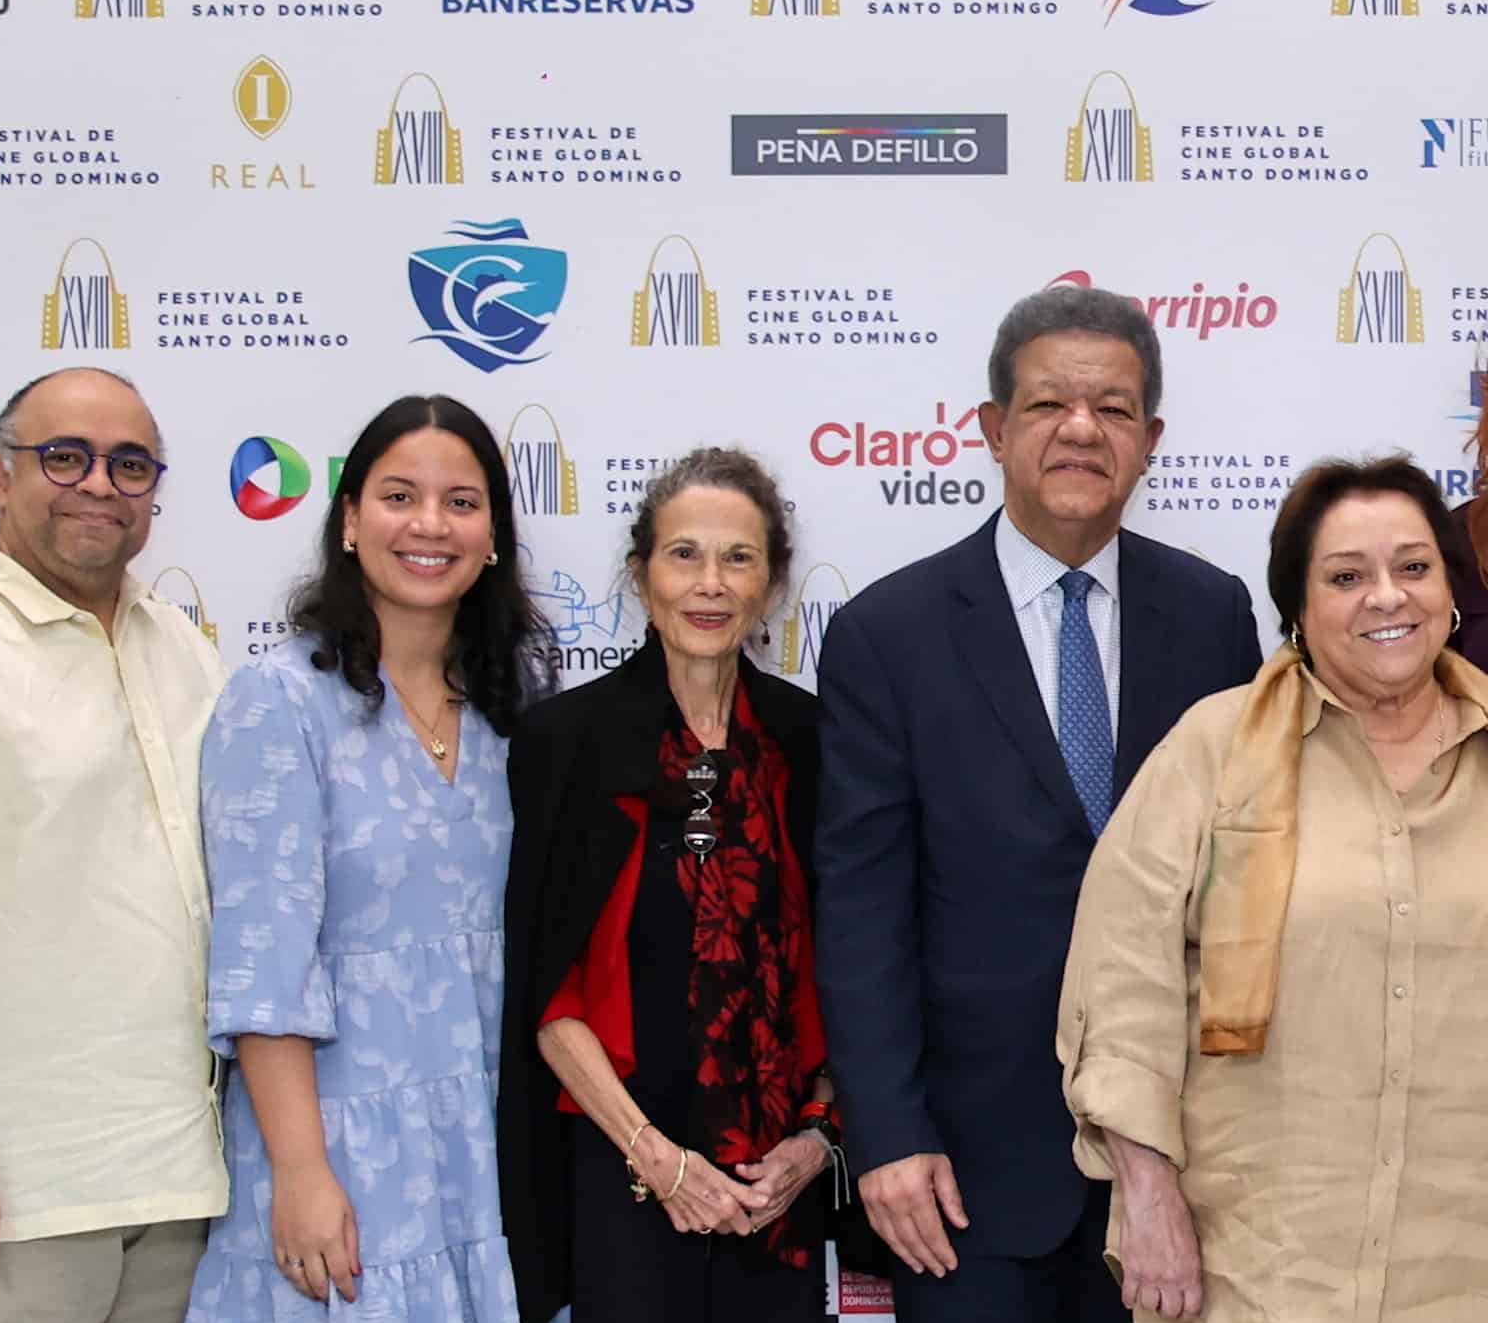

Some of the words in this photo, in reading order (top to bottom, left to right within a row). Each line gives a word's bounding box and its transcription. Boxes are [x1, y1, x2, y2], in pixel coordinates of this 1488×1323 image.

[192, 4, 265, 17] SANTO
[278, 3, 383, 17] DOMINGO
[867, 2, 941, 15] SANTO
[953, 1, 1058, 15] DOMINGO
[88, 129, 114, 142] DE
[1181, 125, 1286, 138] FESTIVAL
[1297, 125, 1324, 138] DE
[33, 151, 120, 164] GLOBAL
[852, 139, 978, 163] DEFILLO
[1181, 146, 1232, 159] CINE
[1243, 146, 1330, 159] GLOBAL
[55, 171, 160, 185] DOMINGO
[211, 163, 316, 189] REAL
[1181, 168, 1254, 181] SANTO
[1265, 168, 1369, 181] DOMINGO
[747, 289, 854, 302] FESTIVAL
[866, 288, 893, 302] DE
[747, 310, 799, 324] CINE
[811, 310, 899, 323] GLOBAL
[1130, 282, 1277, 340] rripio
[748, 331, 822, 345] SANTO
[833, 331, 938, 345] DOMINGO
[810, 422, 958, 467] Claro
[1147, 455, 1253, 468] FESTIVAL
[1264, 455, 1291, 467] DE
[880, 470, 986, 506] video
[1147, 476, 1200, 489] CINE
[1147, 498, 1221, 511] SANTO
